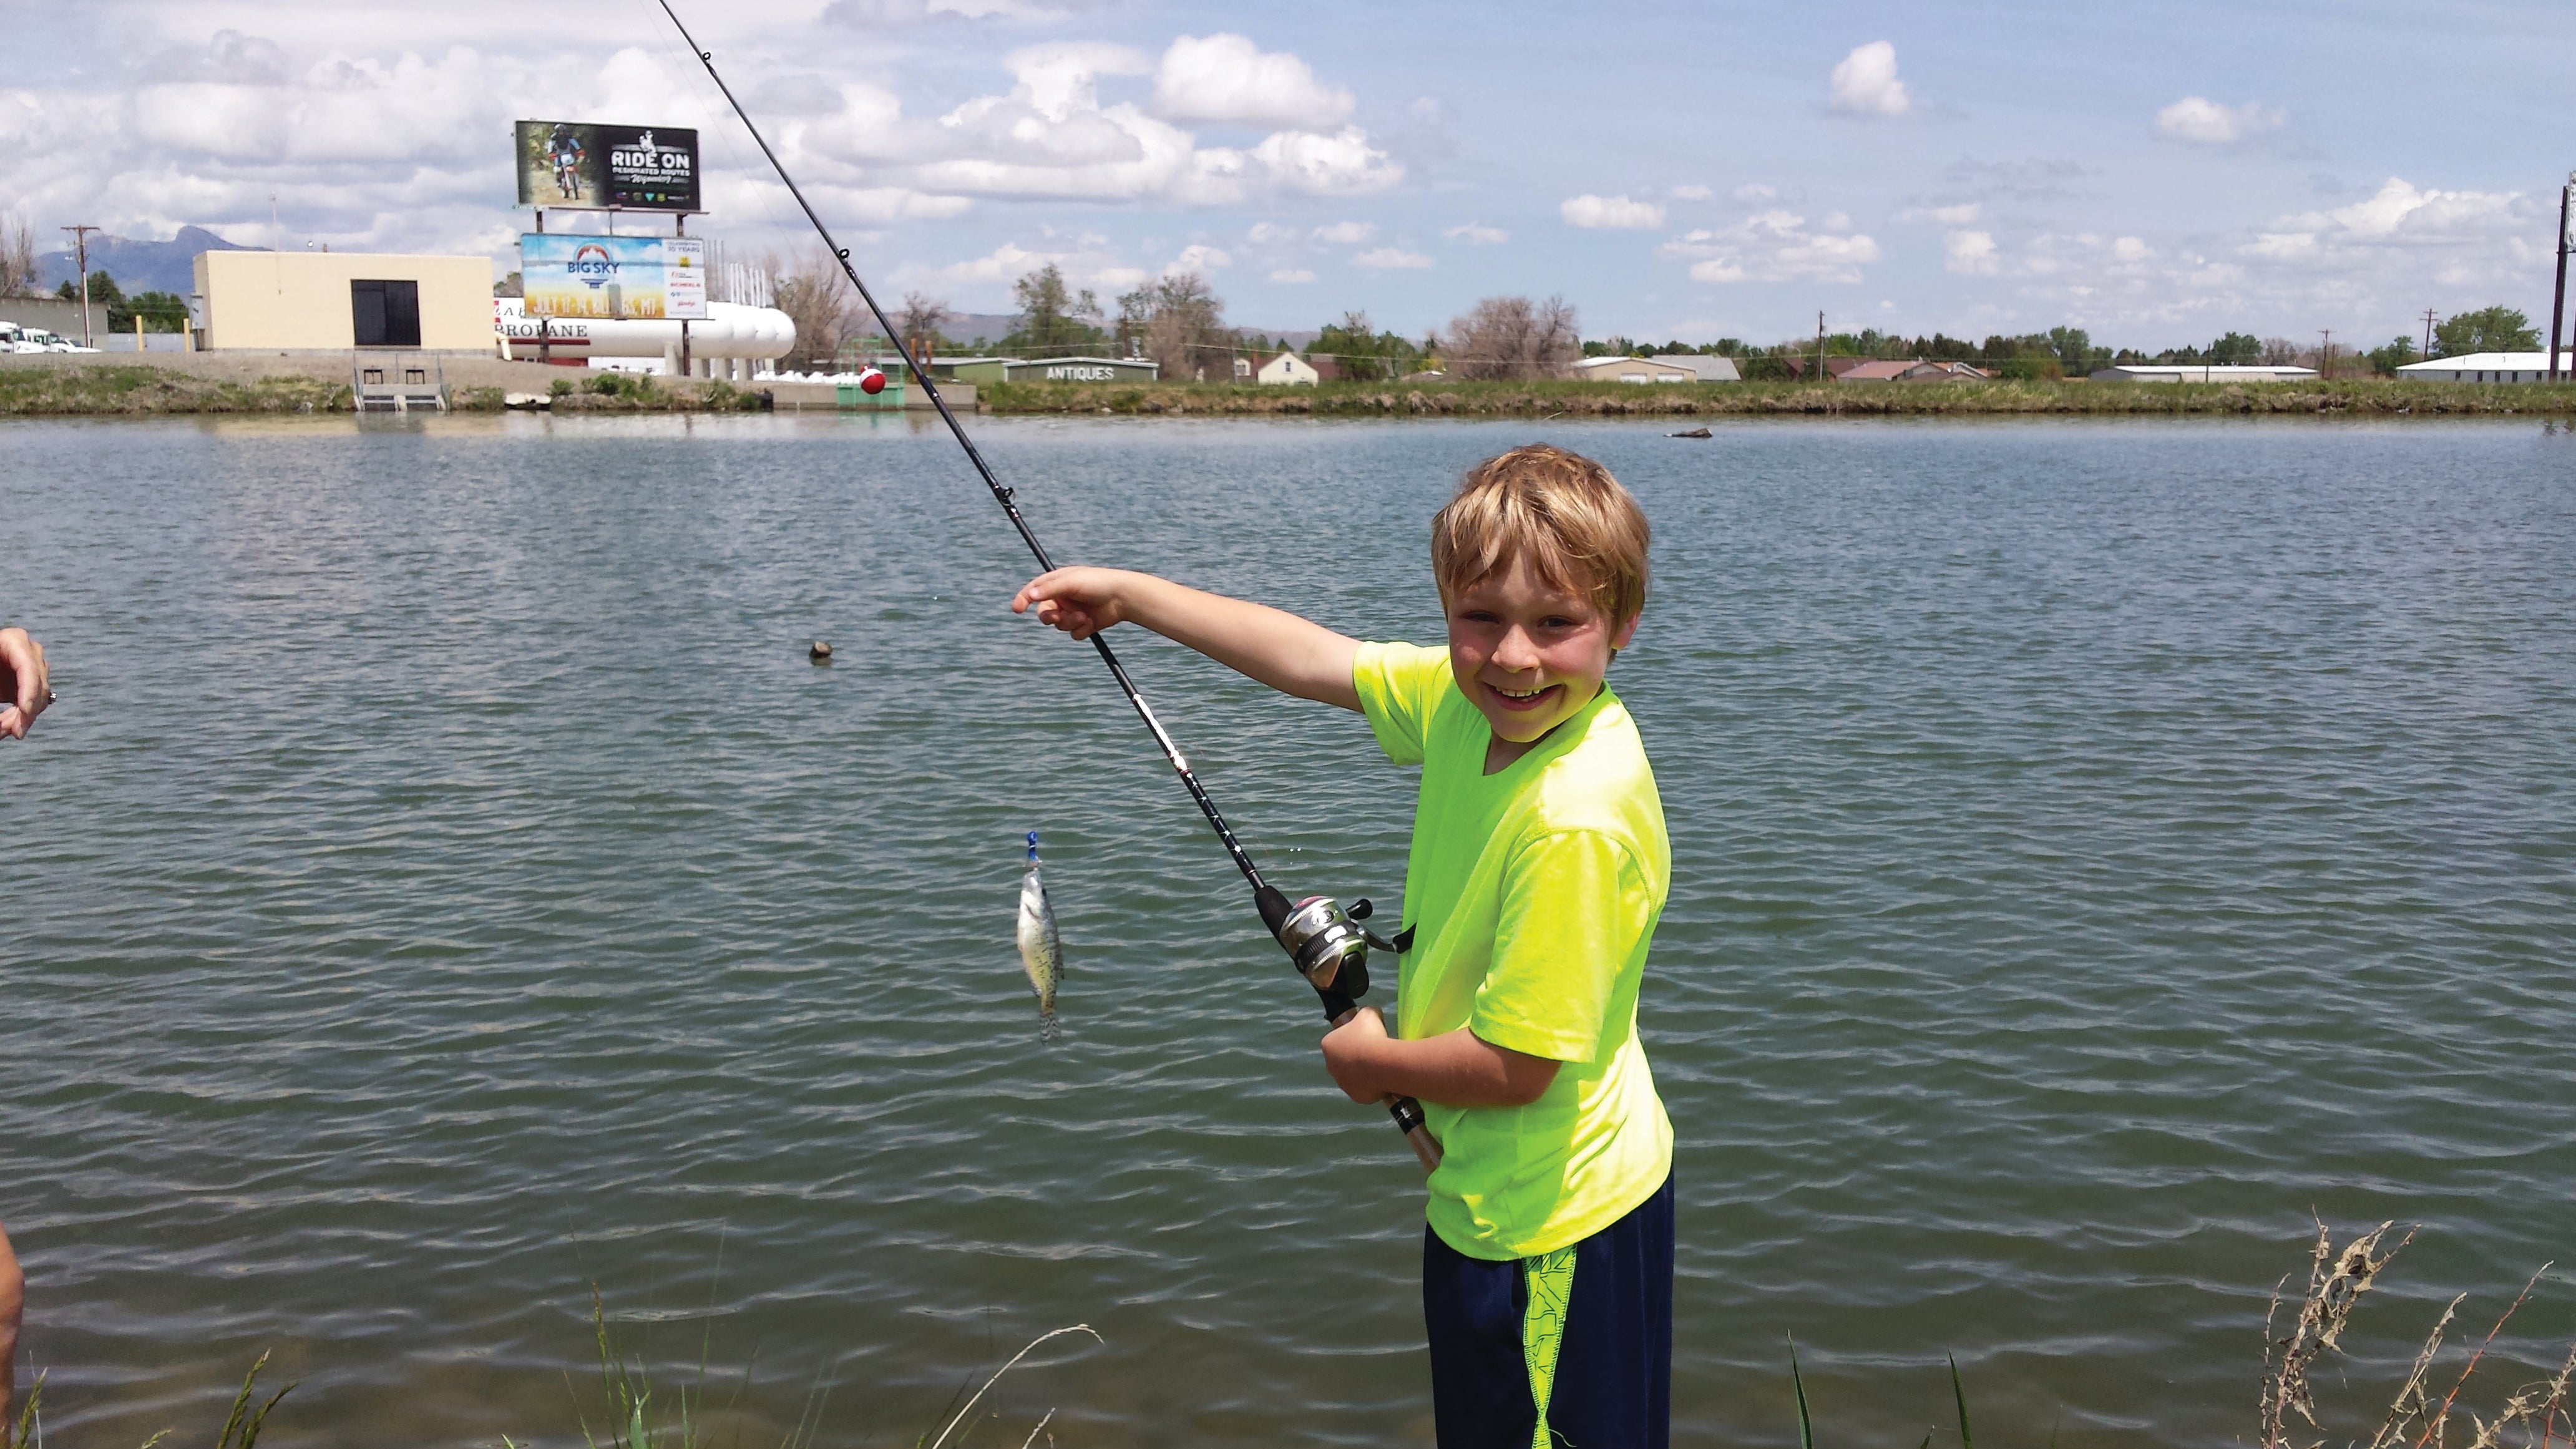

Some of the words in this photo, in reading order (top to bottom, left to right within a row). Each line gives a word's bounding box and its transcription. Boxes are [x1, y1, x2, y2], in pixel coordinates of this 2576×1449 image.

[612, 151, 658, 167] RIDE
[661, 154, 690, 168] ON
[568, 261, 590, 273] BIG
[593, 262, 620, 274] SKY
[494, 324, 588, 337] PROPANE
[1046, 366, 1115, 382] ANTIQUES
